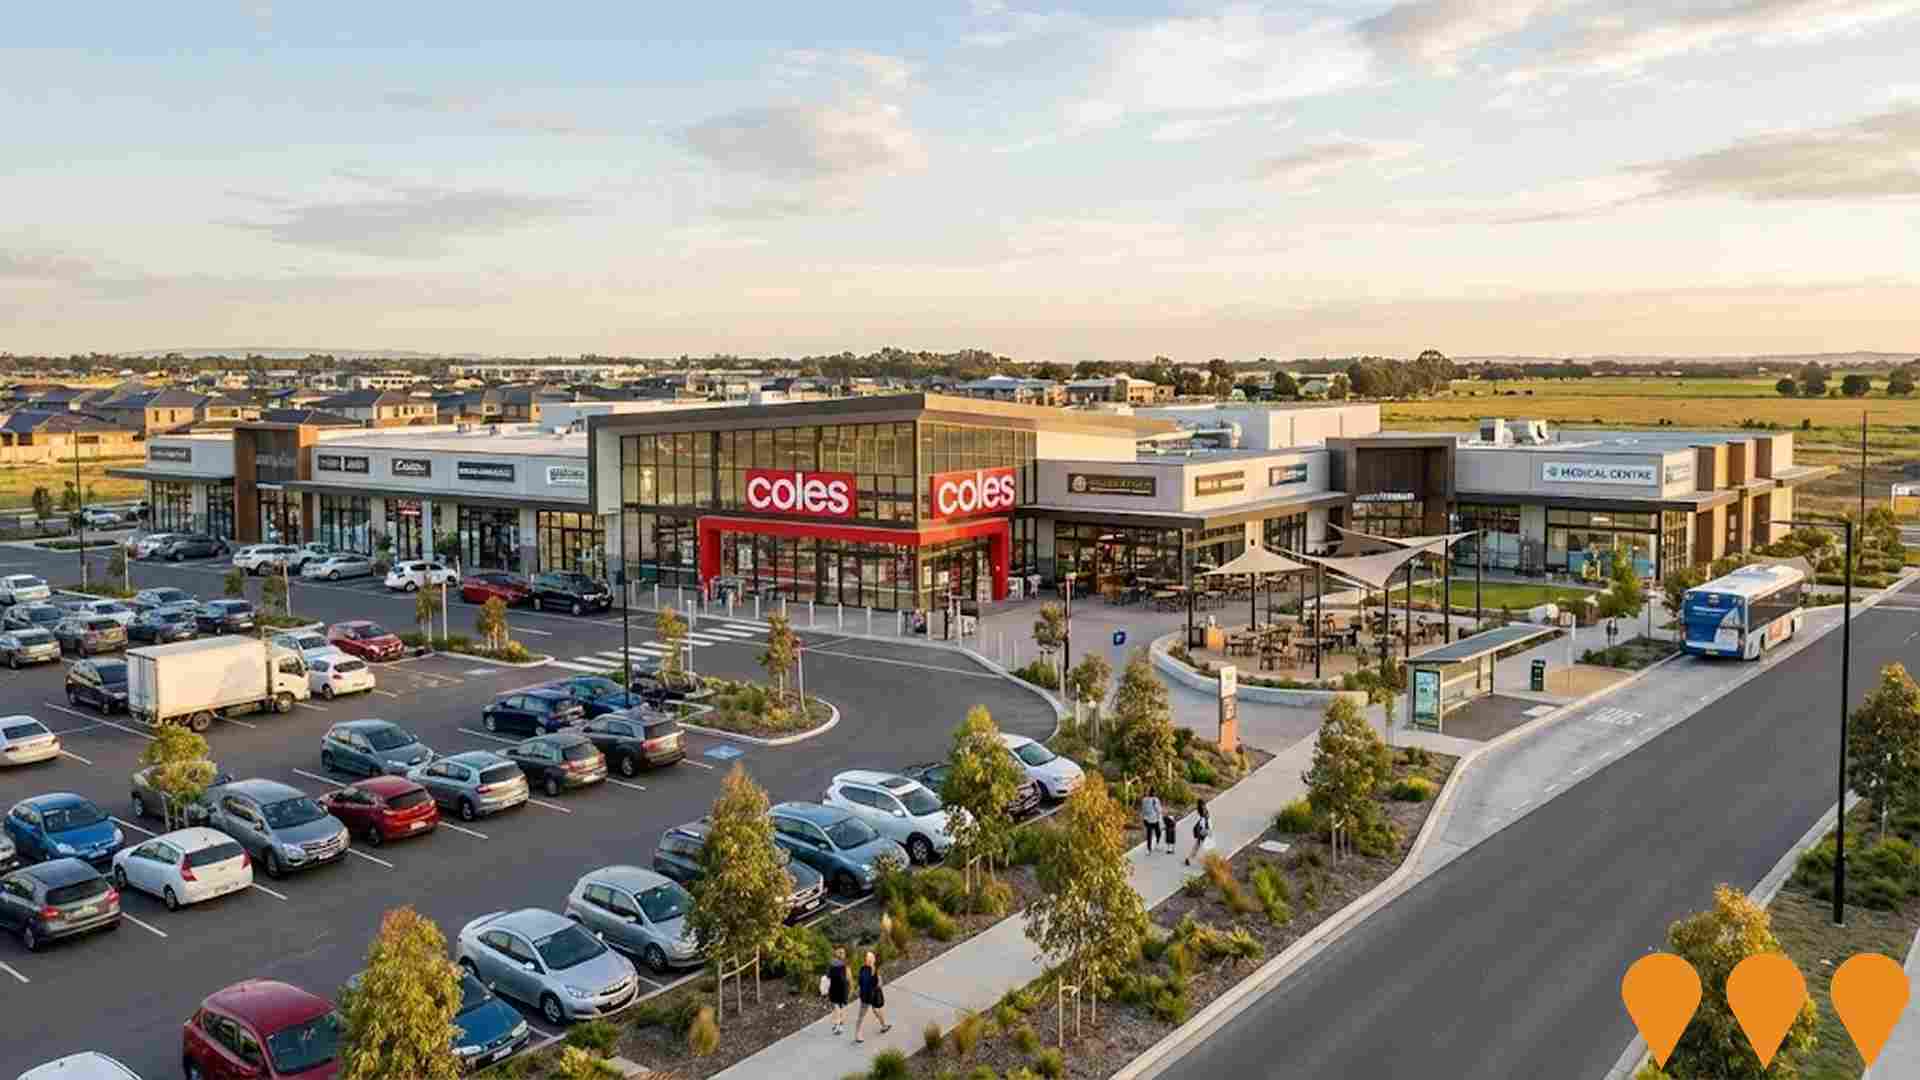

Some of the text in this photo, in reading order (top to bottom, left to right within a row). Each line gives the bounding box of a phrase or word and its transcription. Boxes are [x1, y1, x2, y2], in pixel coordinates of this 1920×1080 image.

[748, 472, 849, 513] coles
[938, 471, 1015, 514] coles
[1561, 467, 1608, 479] MEDICAL
[1610, 469, 1653, 480] CENTRE
